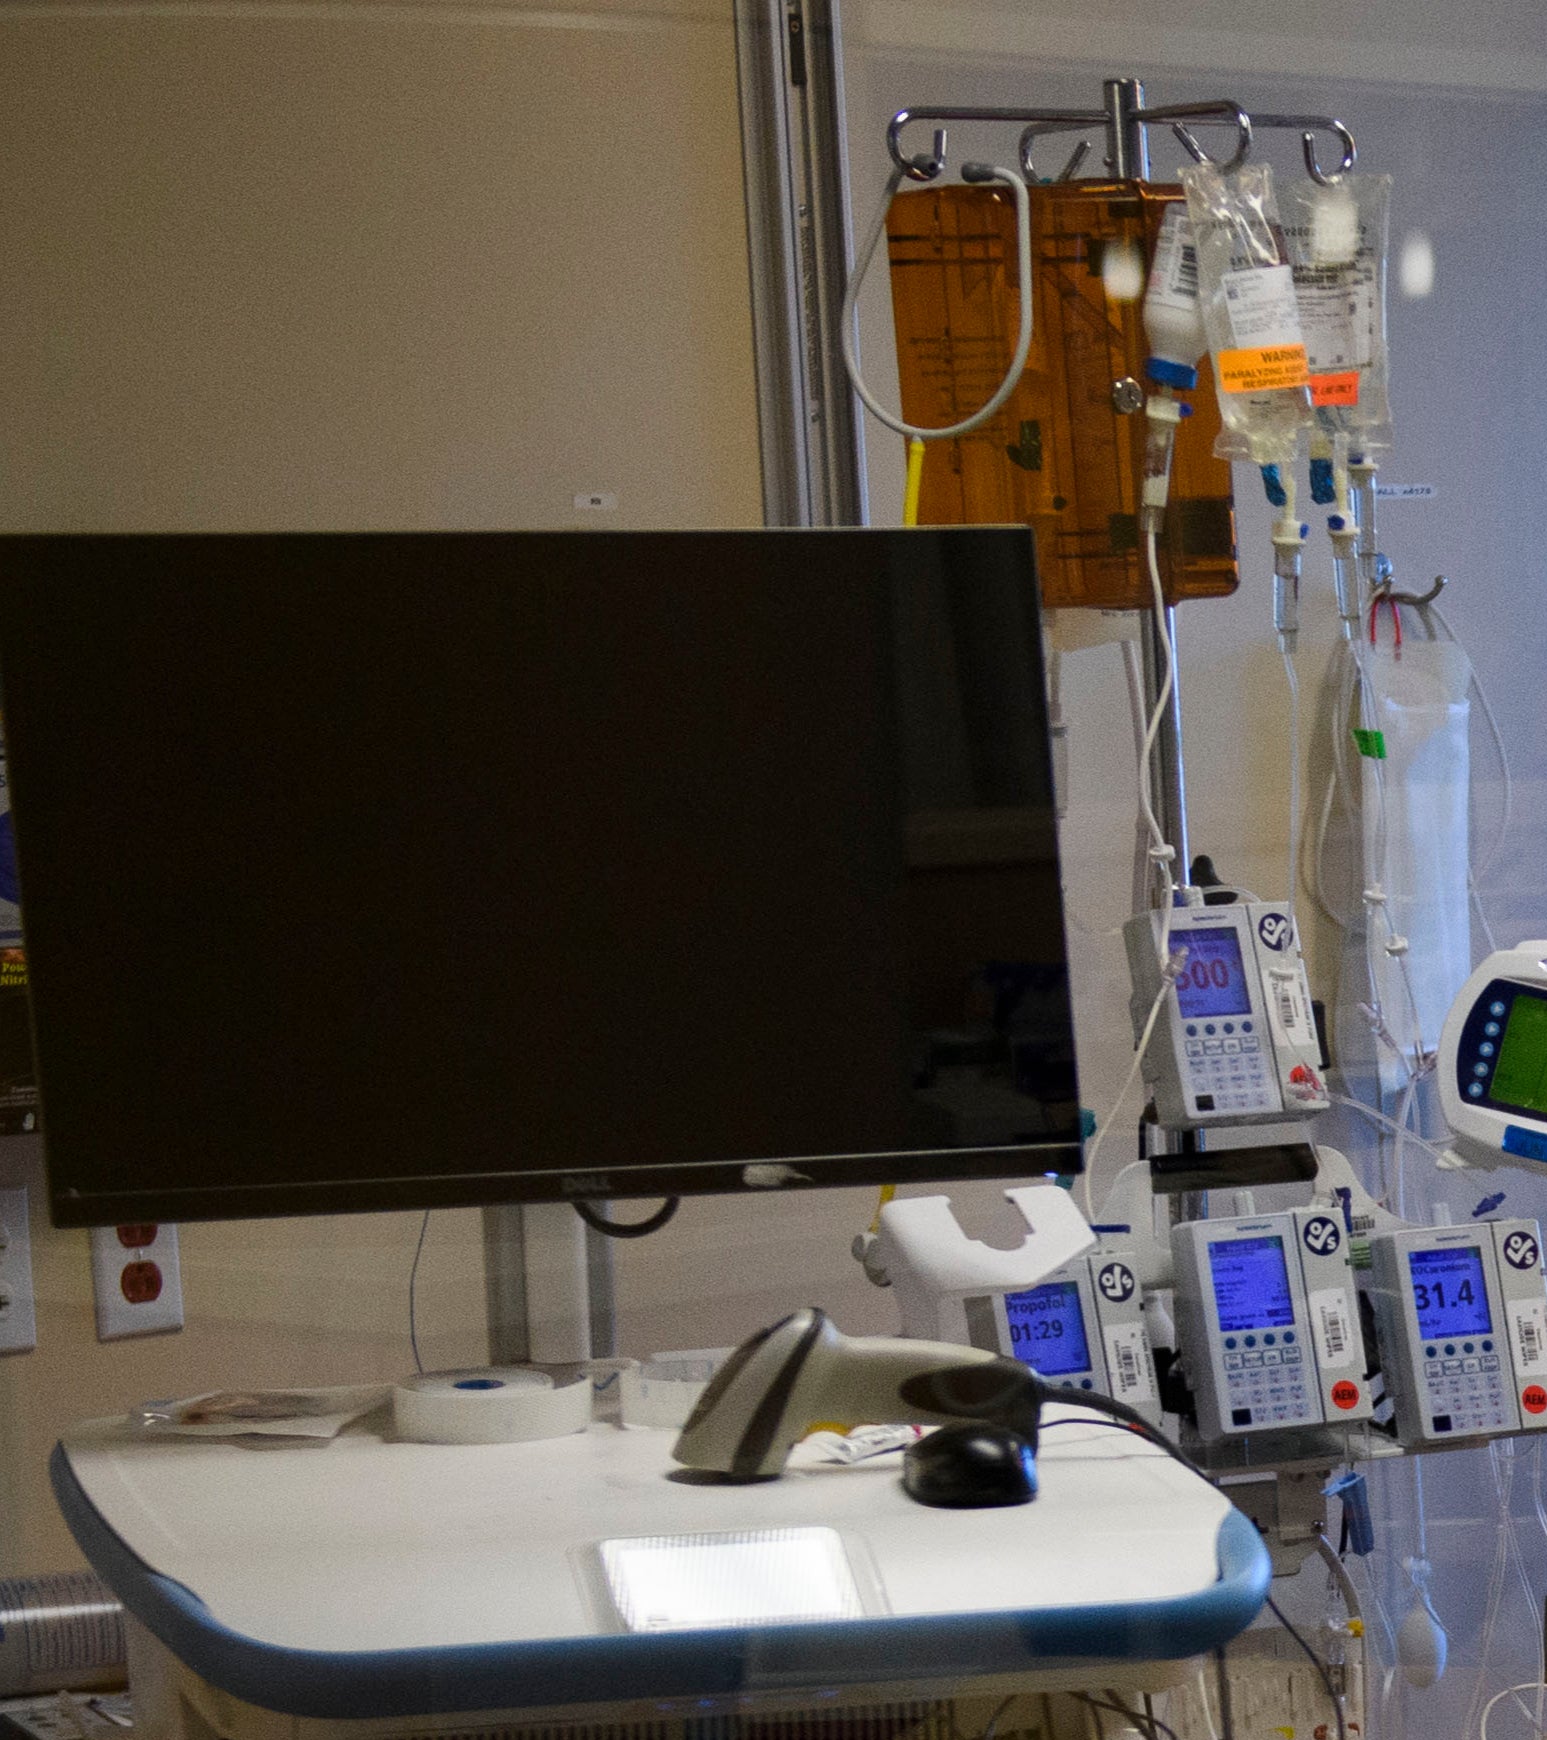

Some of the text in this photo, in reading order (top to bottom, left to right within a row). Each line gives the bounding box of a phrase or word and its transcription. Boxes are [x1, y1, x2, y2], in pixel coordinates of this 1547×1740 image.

[1006, 1293, 1066, 1316] Propofol
[1415, 1279, 1475, 1311] 31.4
[1010, 1318, 1064, 1344] 01:29
[1333, 1388, 1357, 1401] AEM
[1525, 1393, 1547, 1405] AEM
